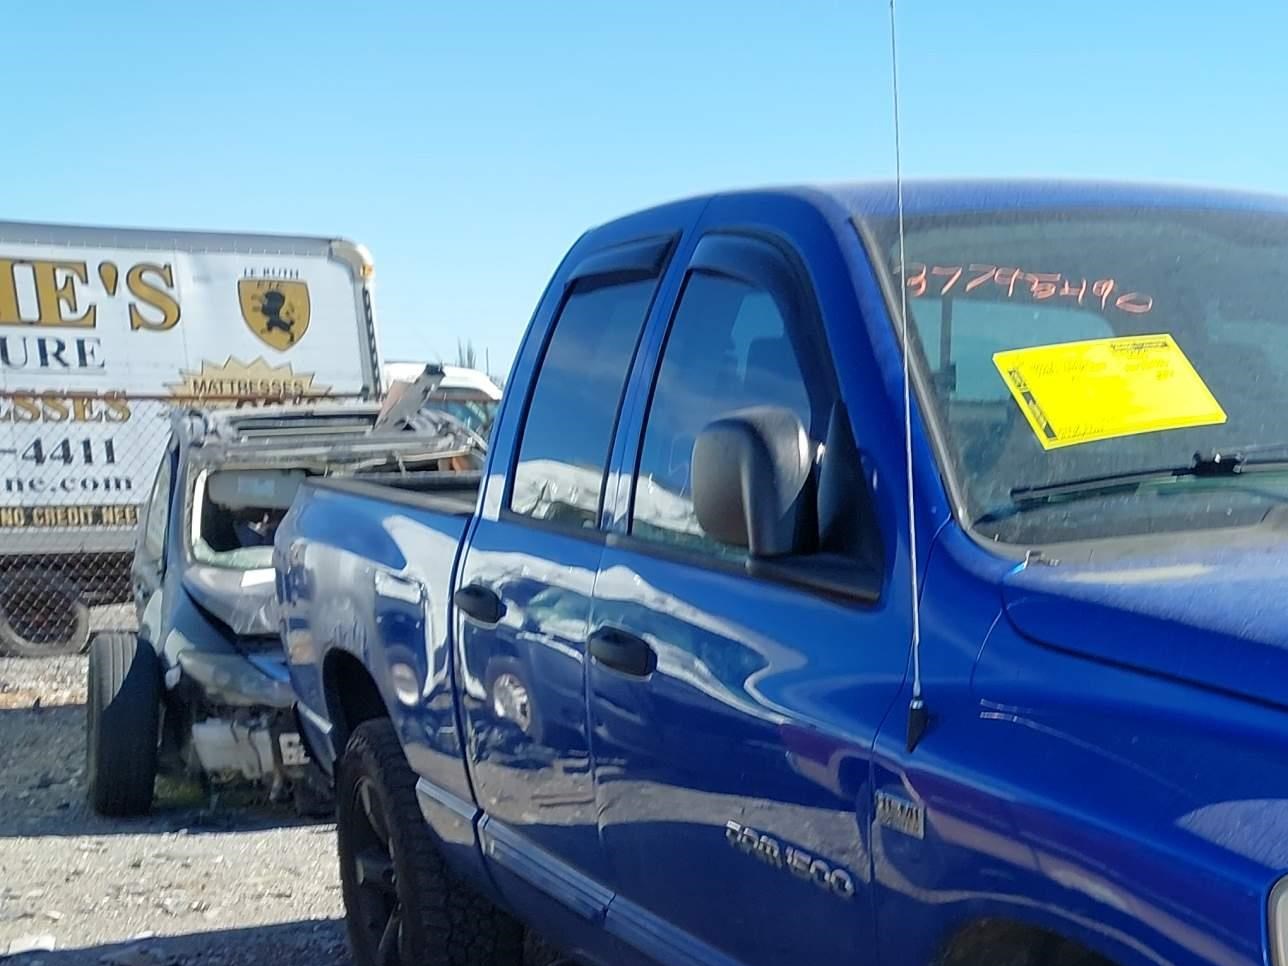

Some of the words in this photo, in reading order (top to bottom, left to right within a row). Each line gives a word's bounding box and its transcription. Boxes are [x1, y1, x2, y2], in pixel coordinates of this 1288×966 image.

[0, 336, 105, 370] URE
[191, 378, 304, 396] MATTRESSES
[32, 507, 93, 527] CREDIT
